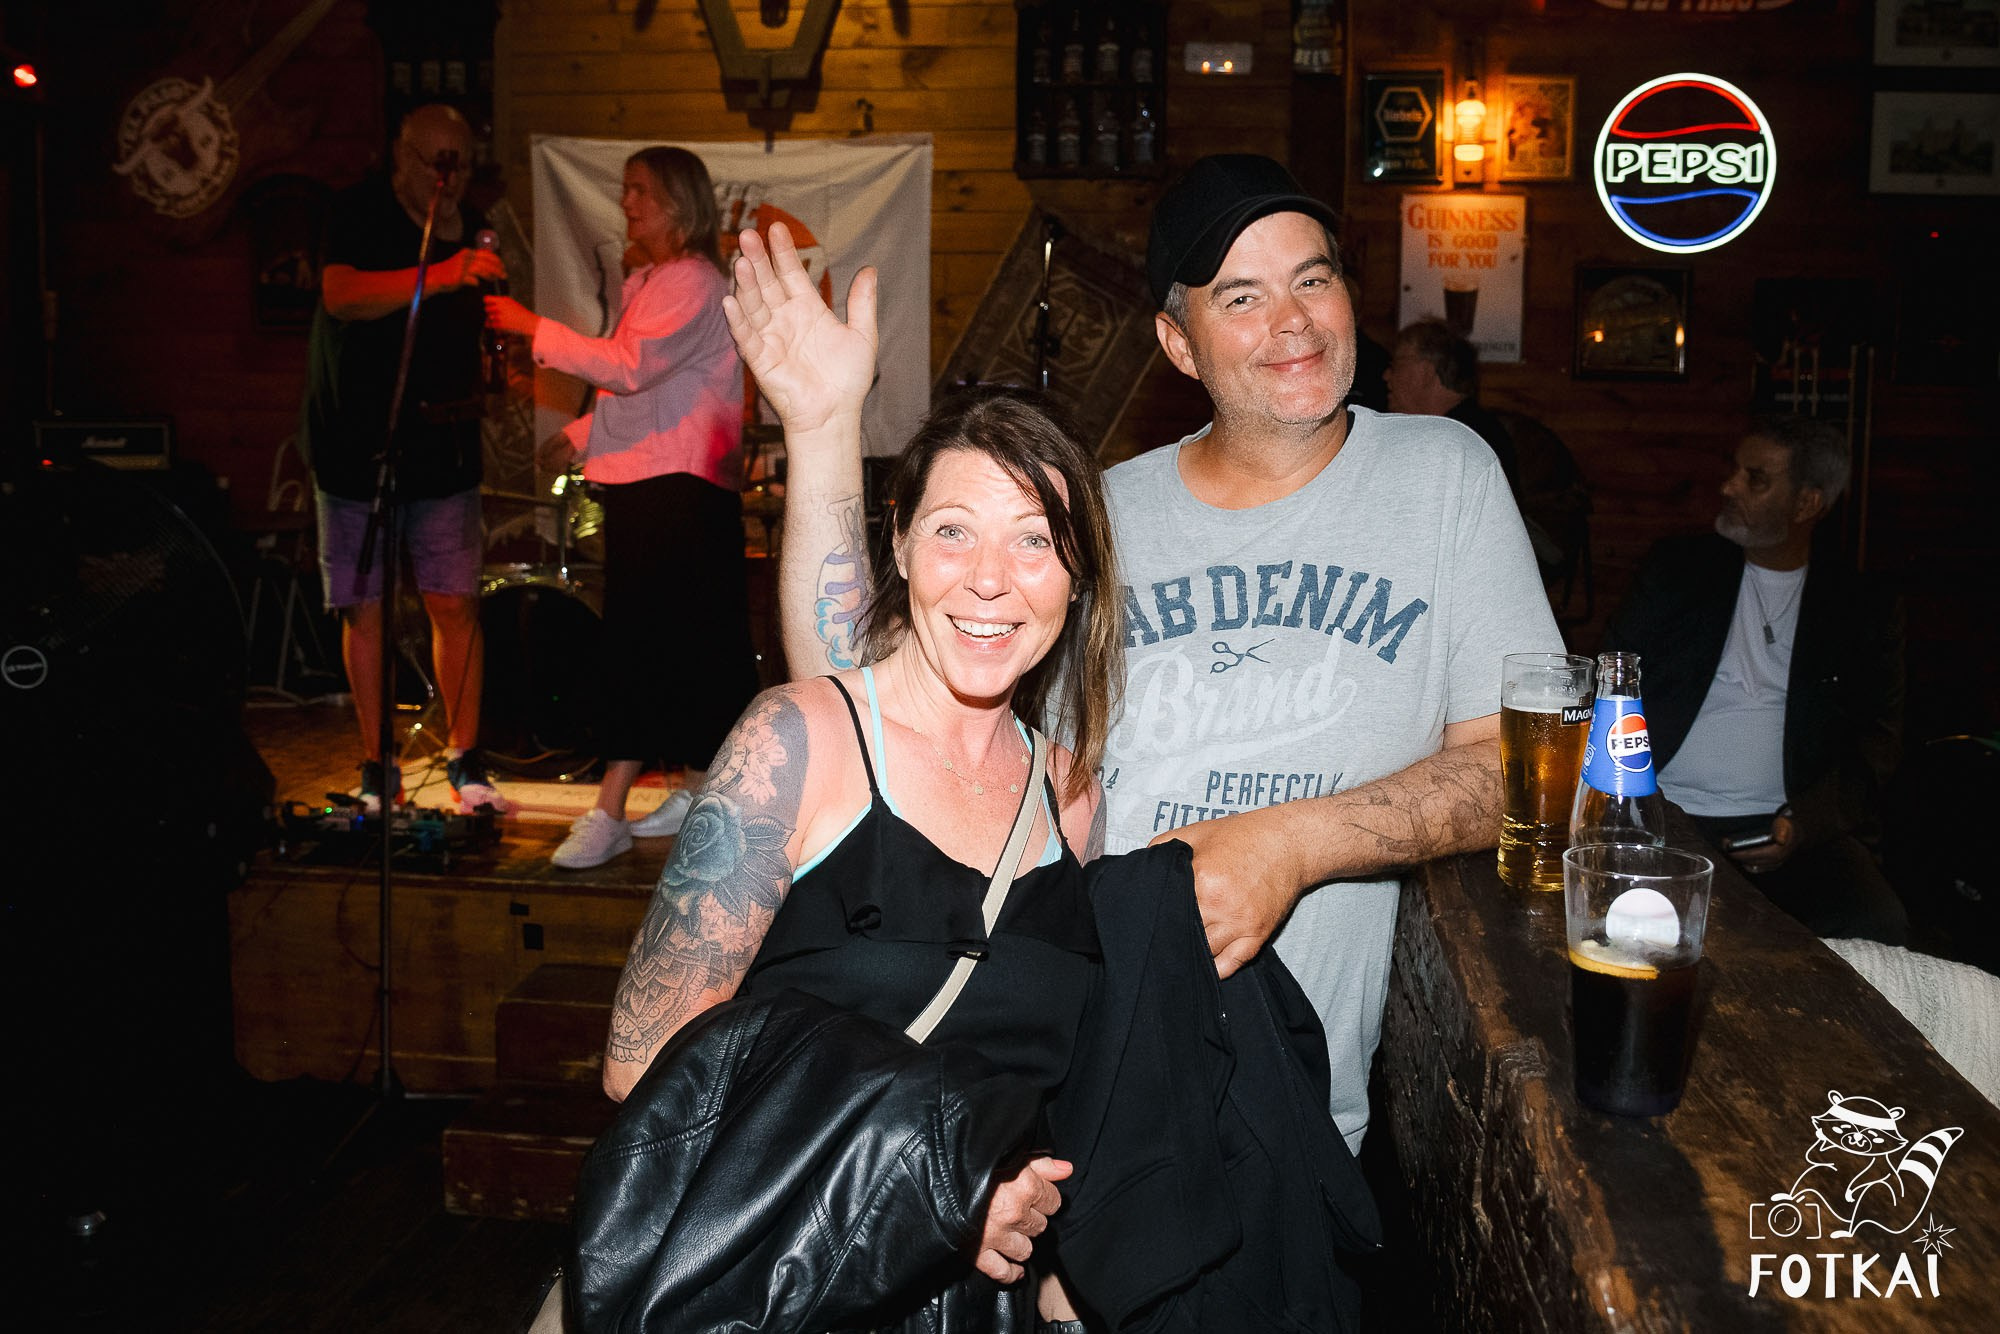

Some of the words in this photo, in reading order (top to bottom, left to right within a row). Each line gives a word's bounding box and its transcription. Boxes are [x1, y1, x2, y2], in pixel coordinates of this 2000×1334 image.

[1606, 142, 1765, 185] PEPSI
[1408, 204, 1518, 232] GUINNESS
[1428, 233, 1443, 248] IS
[1453, 234, 1498, 249] GOOD
[1428, 253, 1459, 268] FOR
[1466, 254, 1498, 268] YOU
[1206, 560, 1429, 665] DENIM
[1153, 800, 1240, 832] FITT
